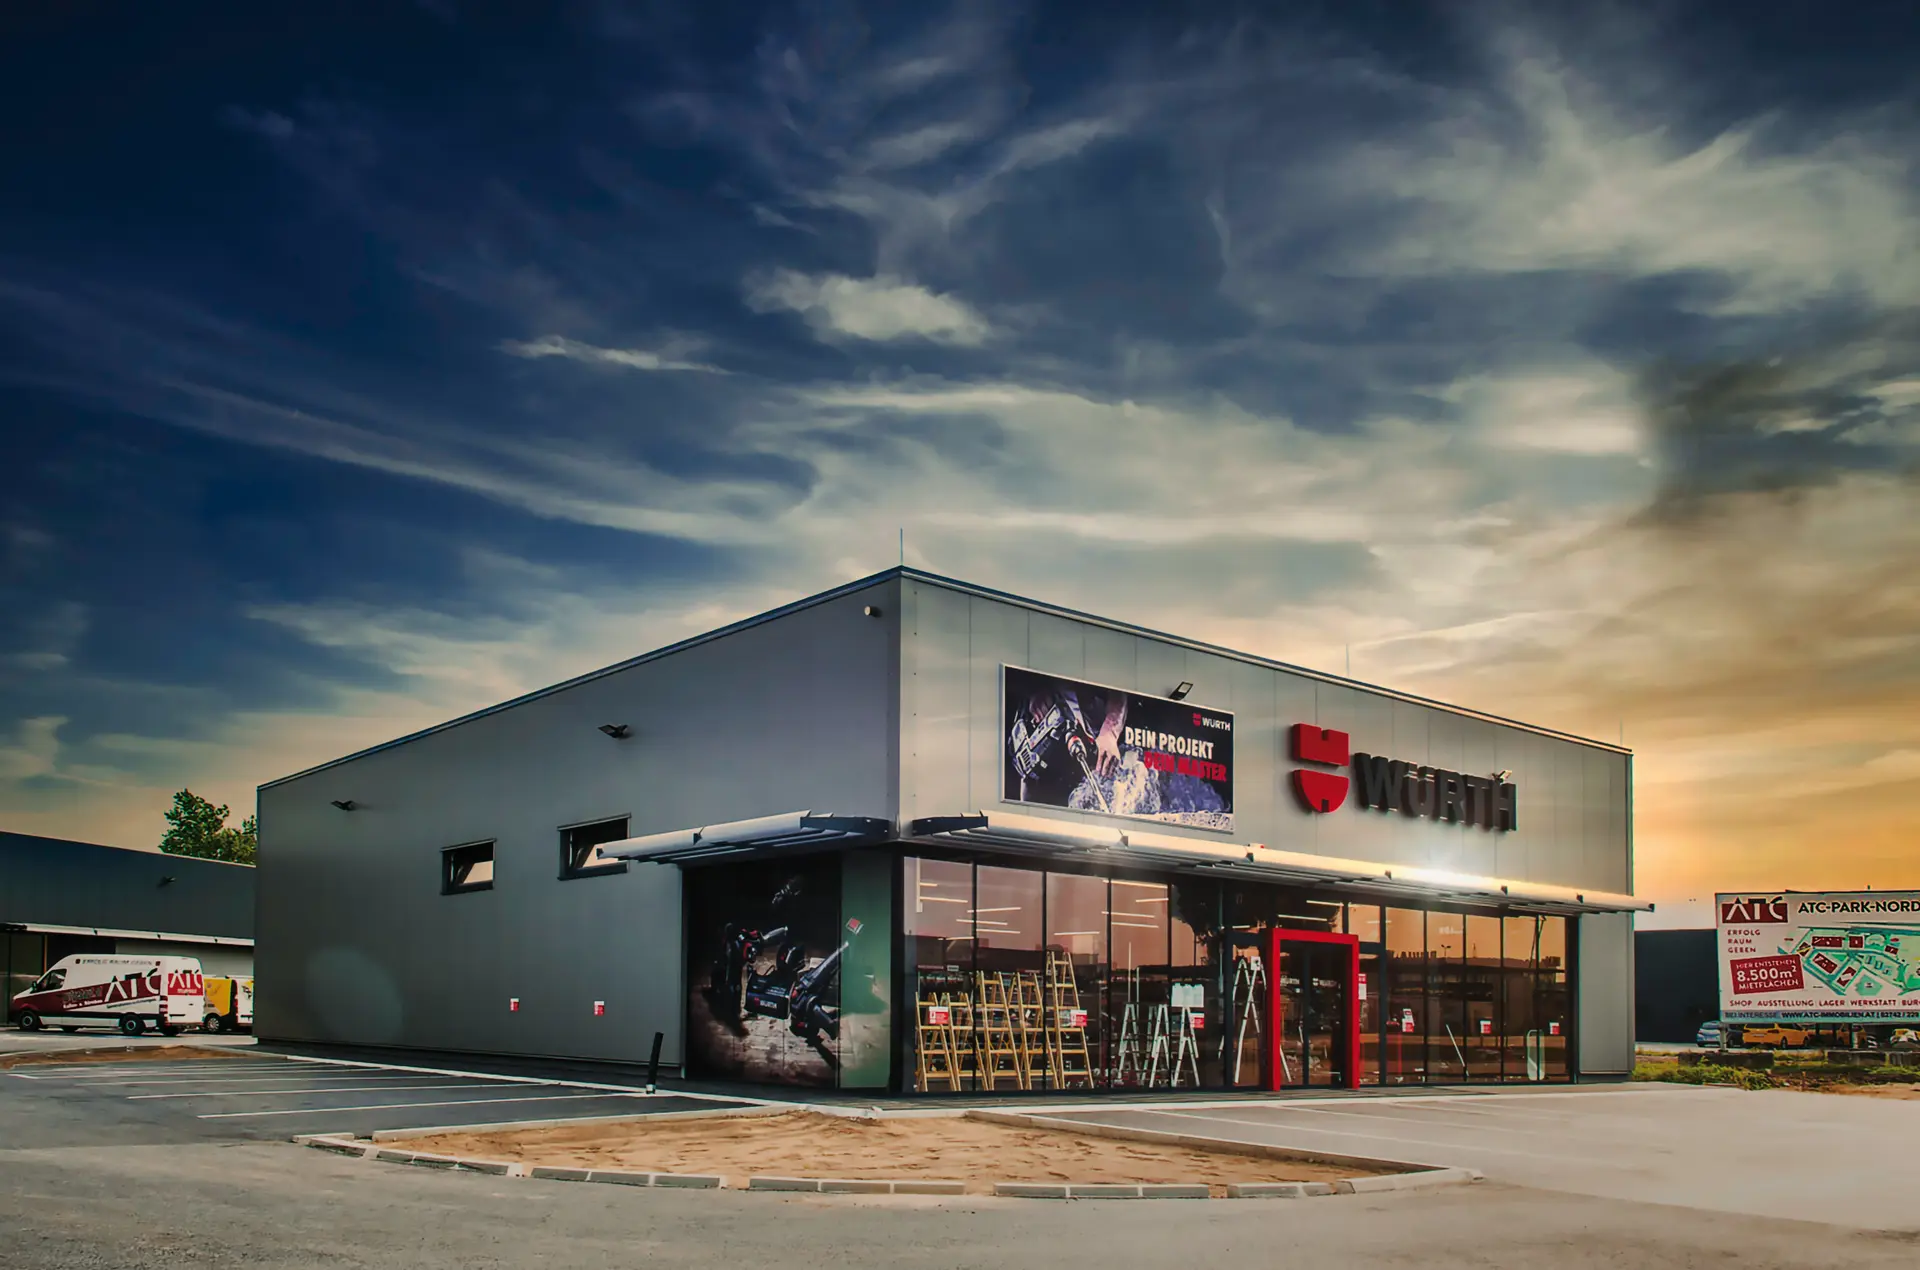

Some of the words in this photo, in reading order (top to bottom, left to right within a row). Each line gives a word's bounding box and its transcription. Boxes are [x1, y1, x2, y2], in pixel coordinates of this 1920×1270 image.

[1125, 726, 1157, 749] DEIN
[1159, 732, 1214, 759] PROJEKT
[1144, 751, 1175, 773] DEIN
[1177, 757, 1227, 782] MASTER
[1354, 752, 1517, 832] WÜRTH
[1725, 896, 1784, 921] ATC
[1798, 900, 1920, 914] ATC-PARK-NORD
[104, 968, 160, 1003] ATC
[169, 969, 202, 989] ATC
[1729, 999, 1752, 1007] SHOP
[1757, 999, 1815, 1007] AUSSTELLUNG
